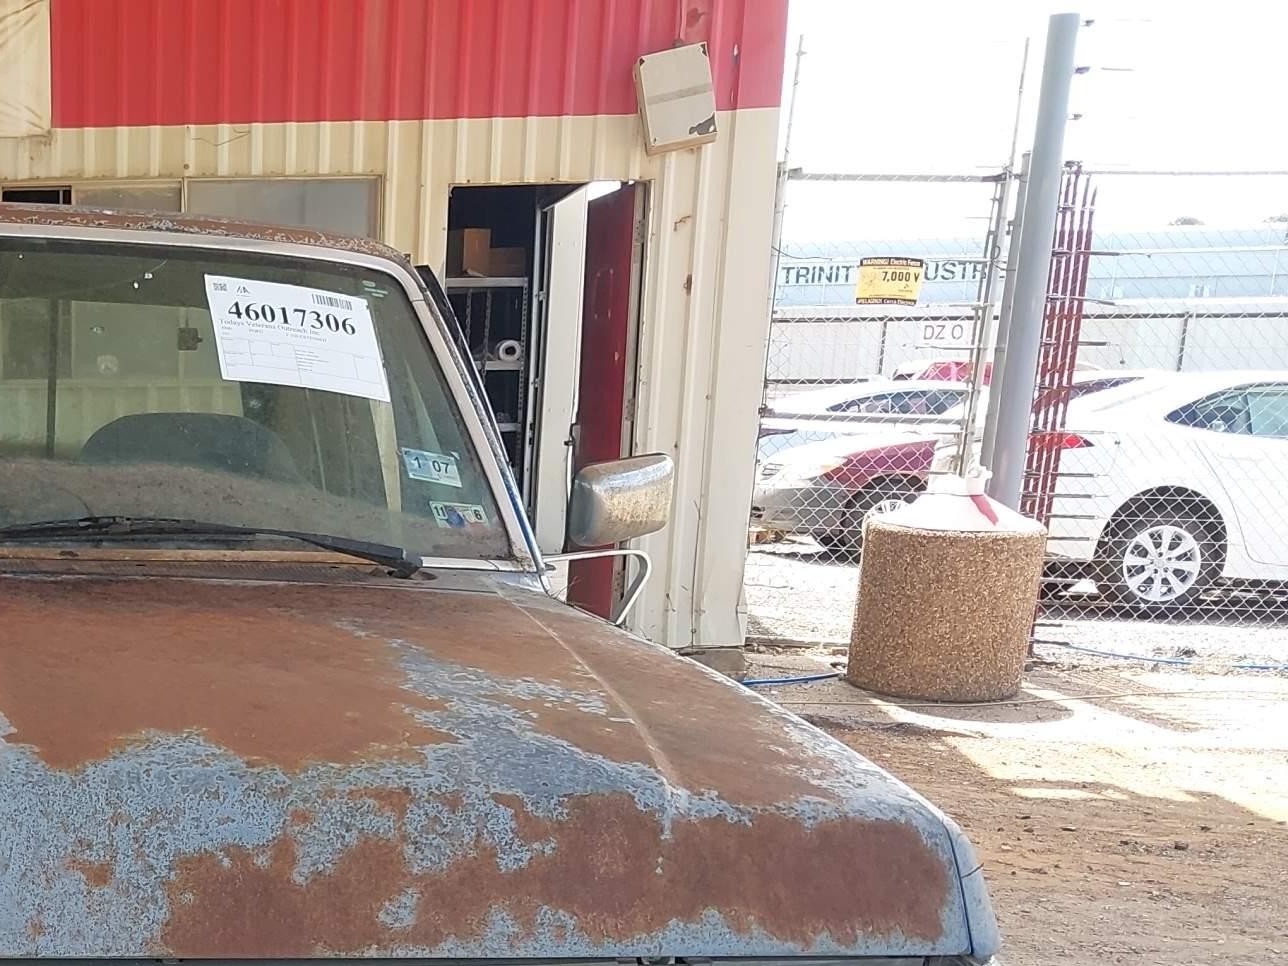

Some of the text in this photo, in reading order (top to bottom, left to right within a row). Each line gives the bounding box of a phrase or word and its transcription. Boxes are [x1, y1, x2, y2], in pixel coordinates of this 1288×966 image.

[781, 265, 858, 284] TRINIT
[882, 271, 911, 283] 7,000
[228, 301, 355, 335] 46017306
[432, 460, 450, 474] 07
